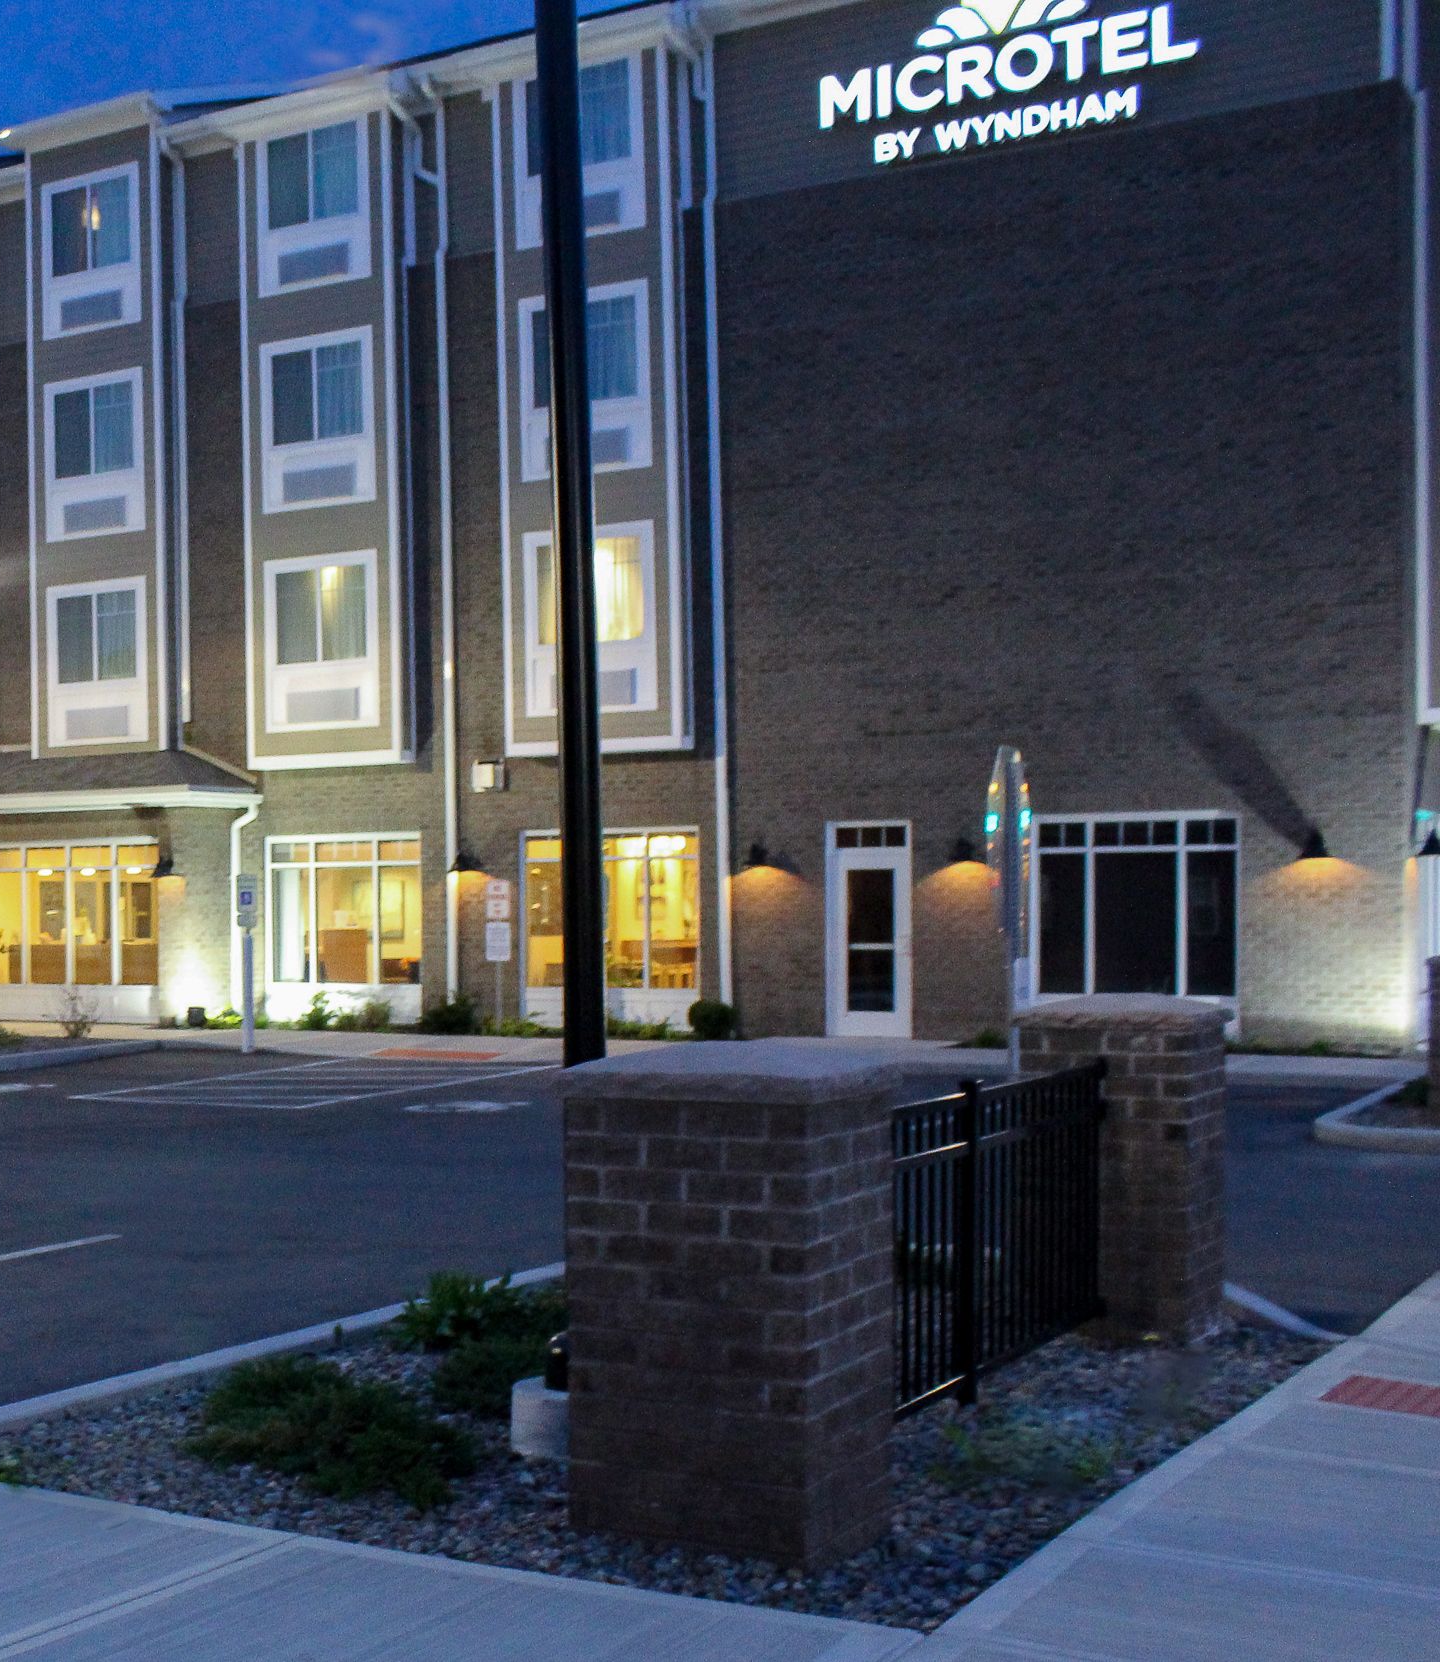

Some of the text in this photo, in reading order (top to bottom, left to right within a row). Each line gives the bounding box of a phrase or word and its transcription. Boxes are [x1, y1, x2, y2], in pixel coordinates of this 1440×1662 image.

[819, 4, 1200, 129] MICROTEL
[873, 85, 1140, 164] BY WYNDHAM
